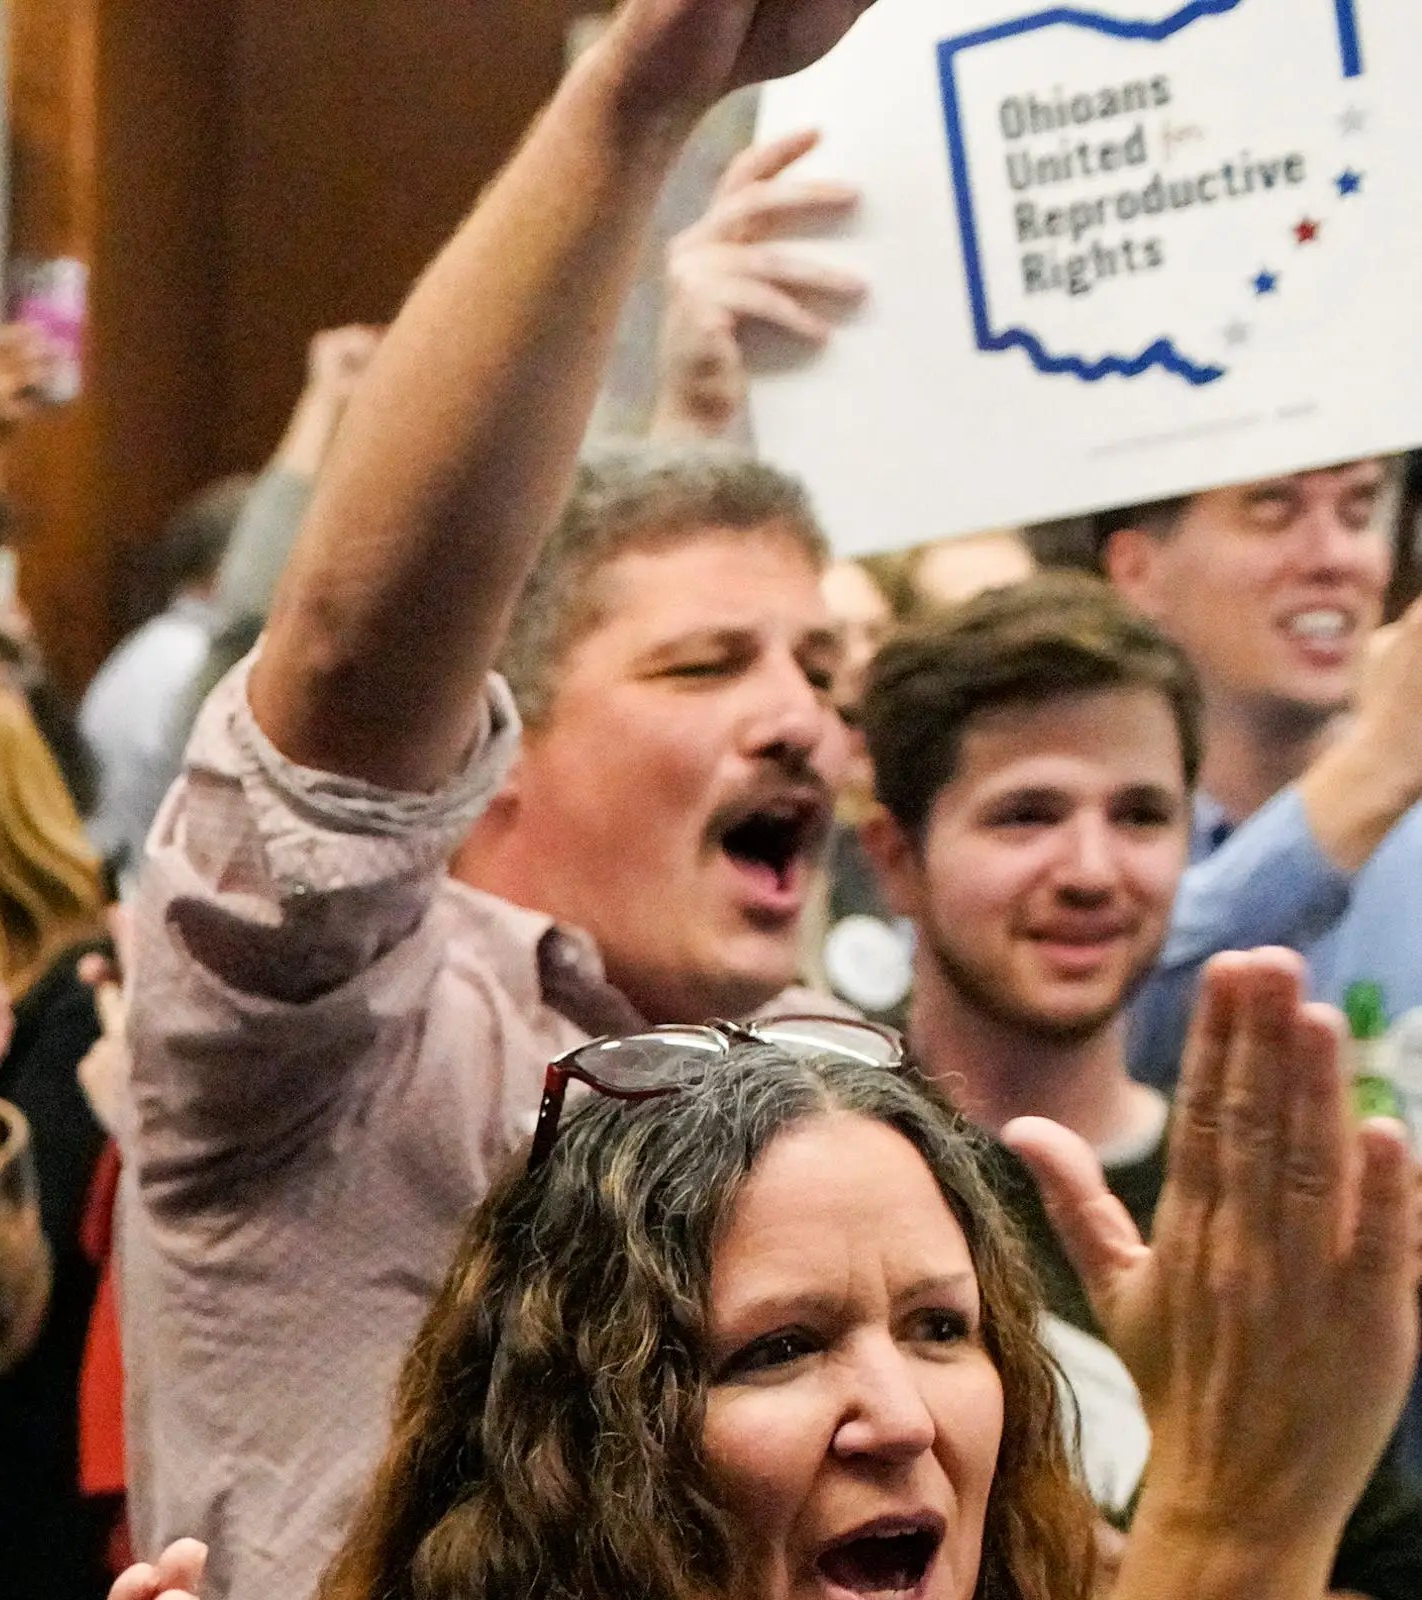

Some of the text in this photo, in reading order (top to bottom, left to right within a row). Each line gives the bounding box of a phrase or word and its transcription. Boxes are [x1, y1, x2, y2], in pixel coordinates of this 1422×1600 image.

[999, 73, 1172, 140] Ohioans
[1005, 125, 1147, 190] United
[1013, 149, 1307, 243] Reproductive
[1020, 234, 1165, 297] Rights
